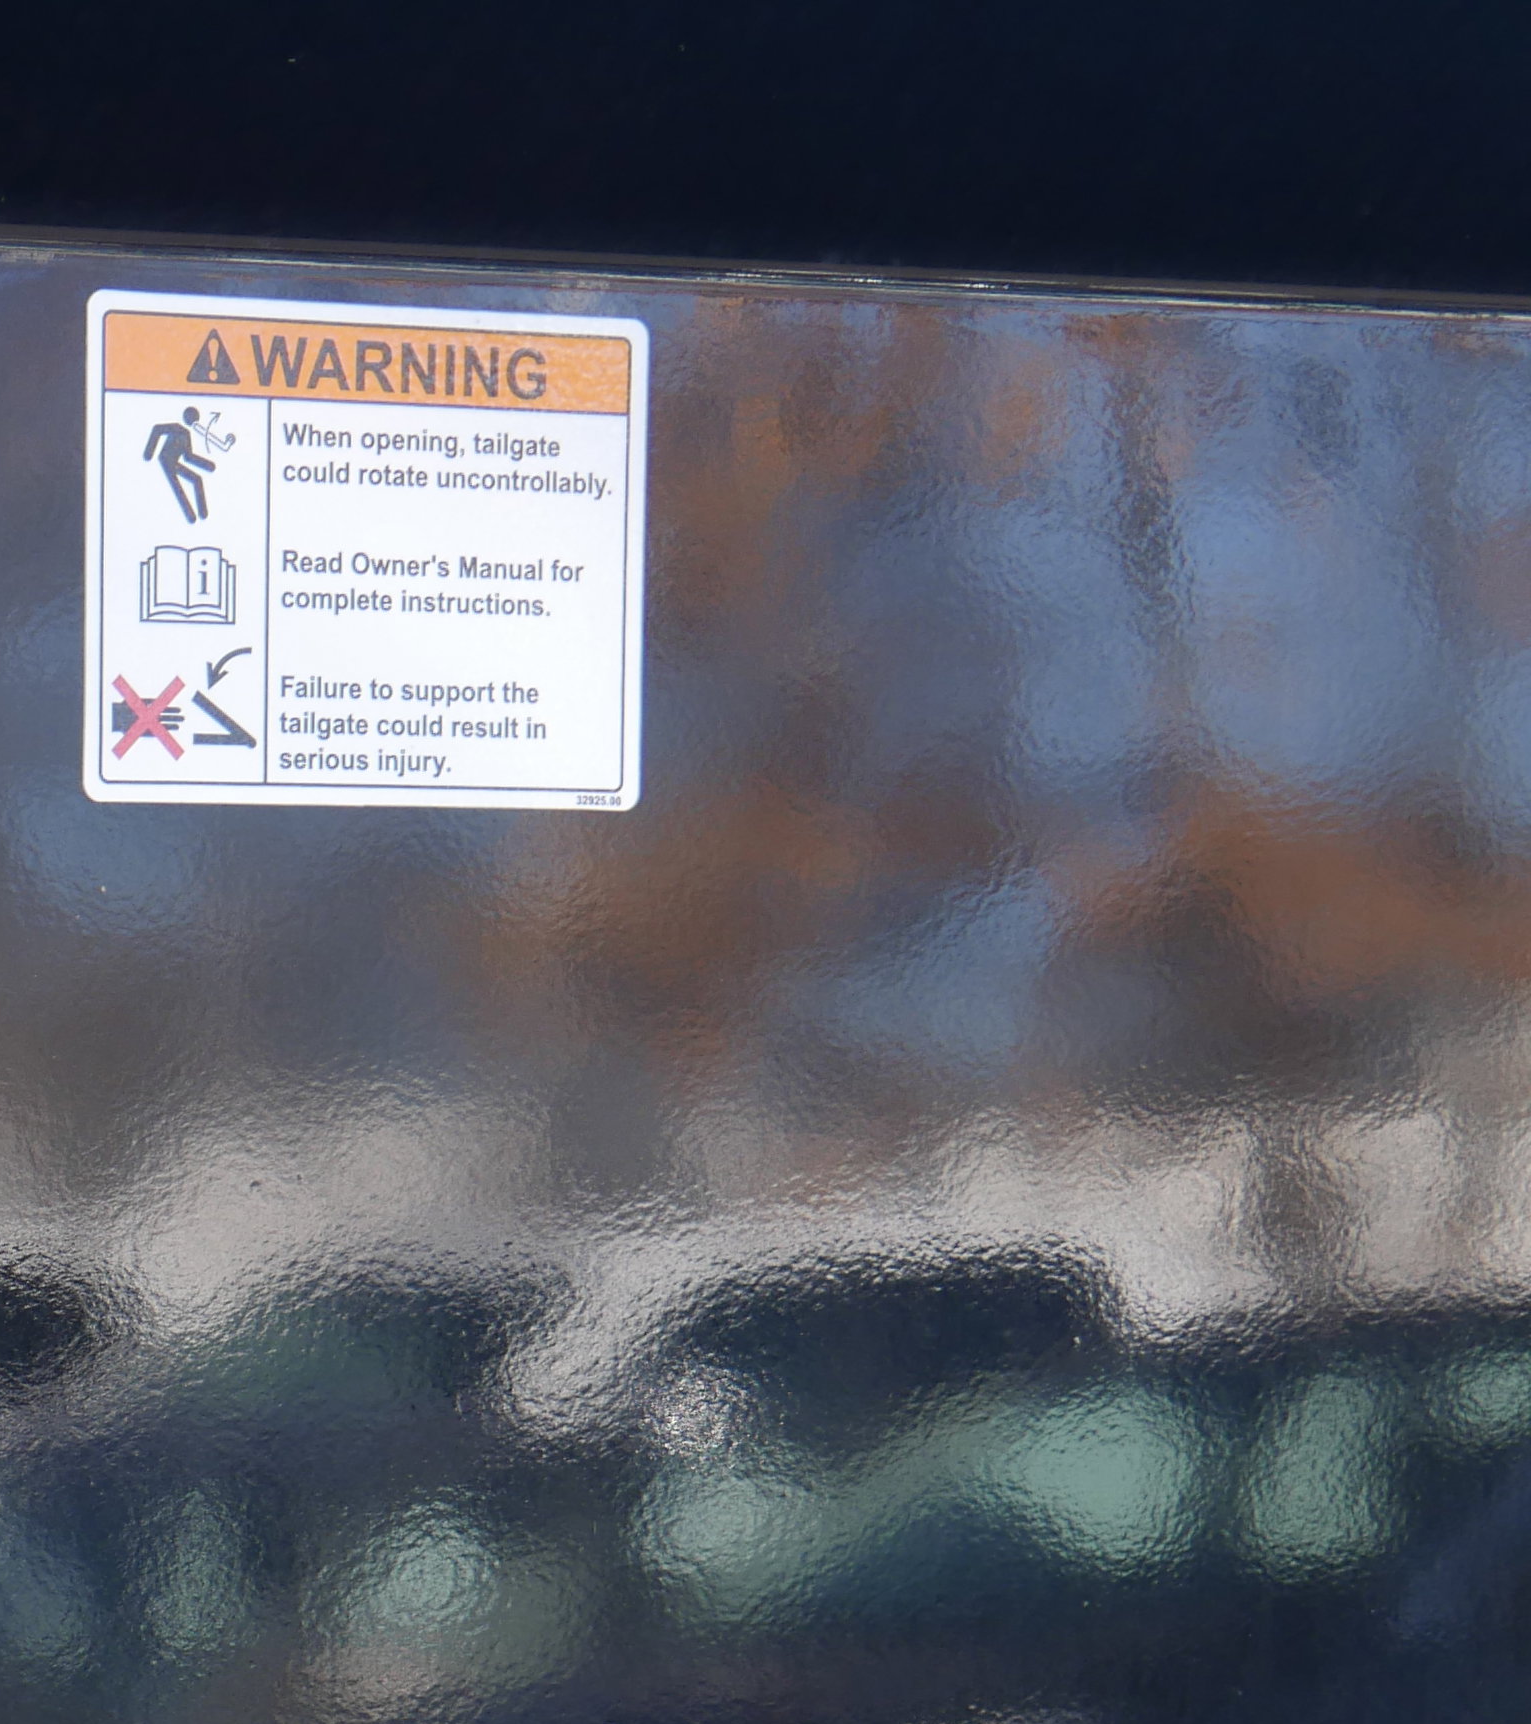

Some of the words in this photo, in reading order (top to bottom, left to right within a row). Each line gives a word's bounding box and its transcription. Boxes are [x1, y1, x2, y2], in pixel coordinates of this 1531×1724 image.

[251, 333, 548, 400] WARNING
[283, 423, 351, 448] When
[361, 429, 464, 459] opening,
[473, 433, 560, 461] tailgate
[283, 461, 349, 484] could
[359, 465, 428, 487] rotate
[437, 470, 611, 500] uncontrollably.
[283, 550, 342, 574] Read
[351, 552, 450, 577] Owner's
[460, 556, 542, 581] Manual
[551, 559, 584, 582] for
[281, 588, 392, 615] complete
[402, 590, 550, 616] instructions.
[281, 675, 361, 699] Failure
[370, 679, 393, 700] to
[401, 682, 495, 707] support
[503, 682, 539, 704] the
[280, 712, 368, 740] tailgate
[377, 715, 442, 737] could
[452, 717, 518, 738] result
[527, 717, 546, 739] in
[280, 748, 368, 770] serious
[379, 749, 451, 778] injury.
